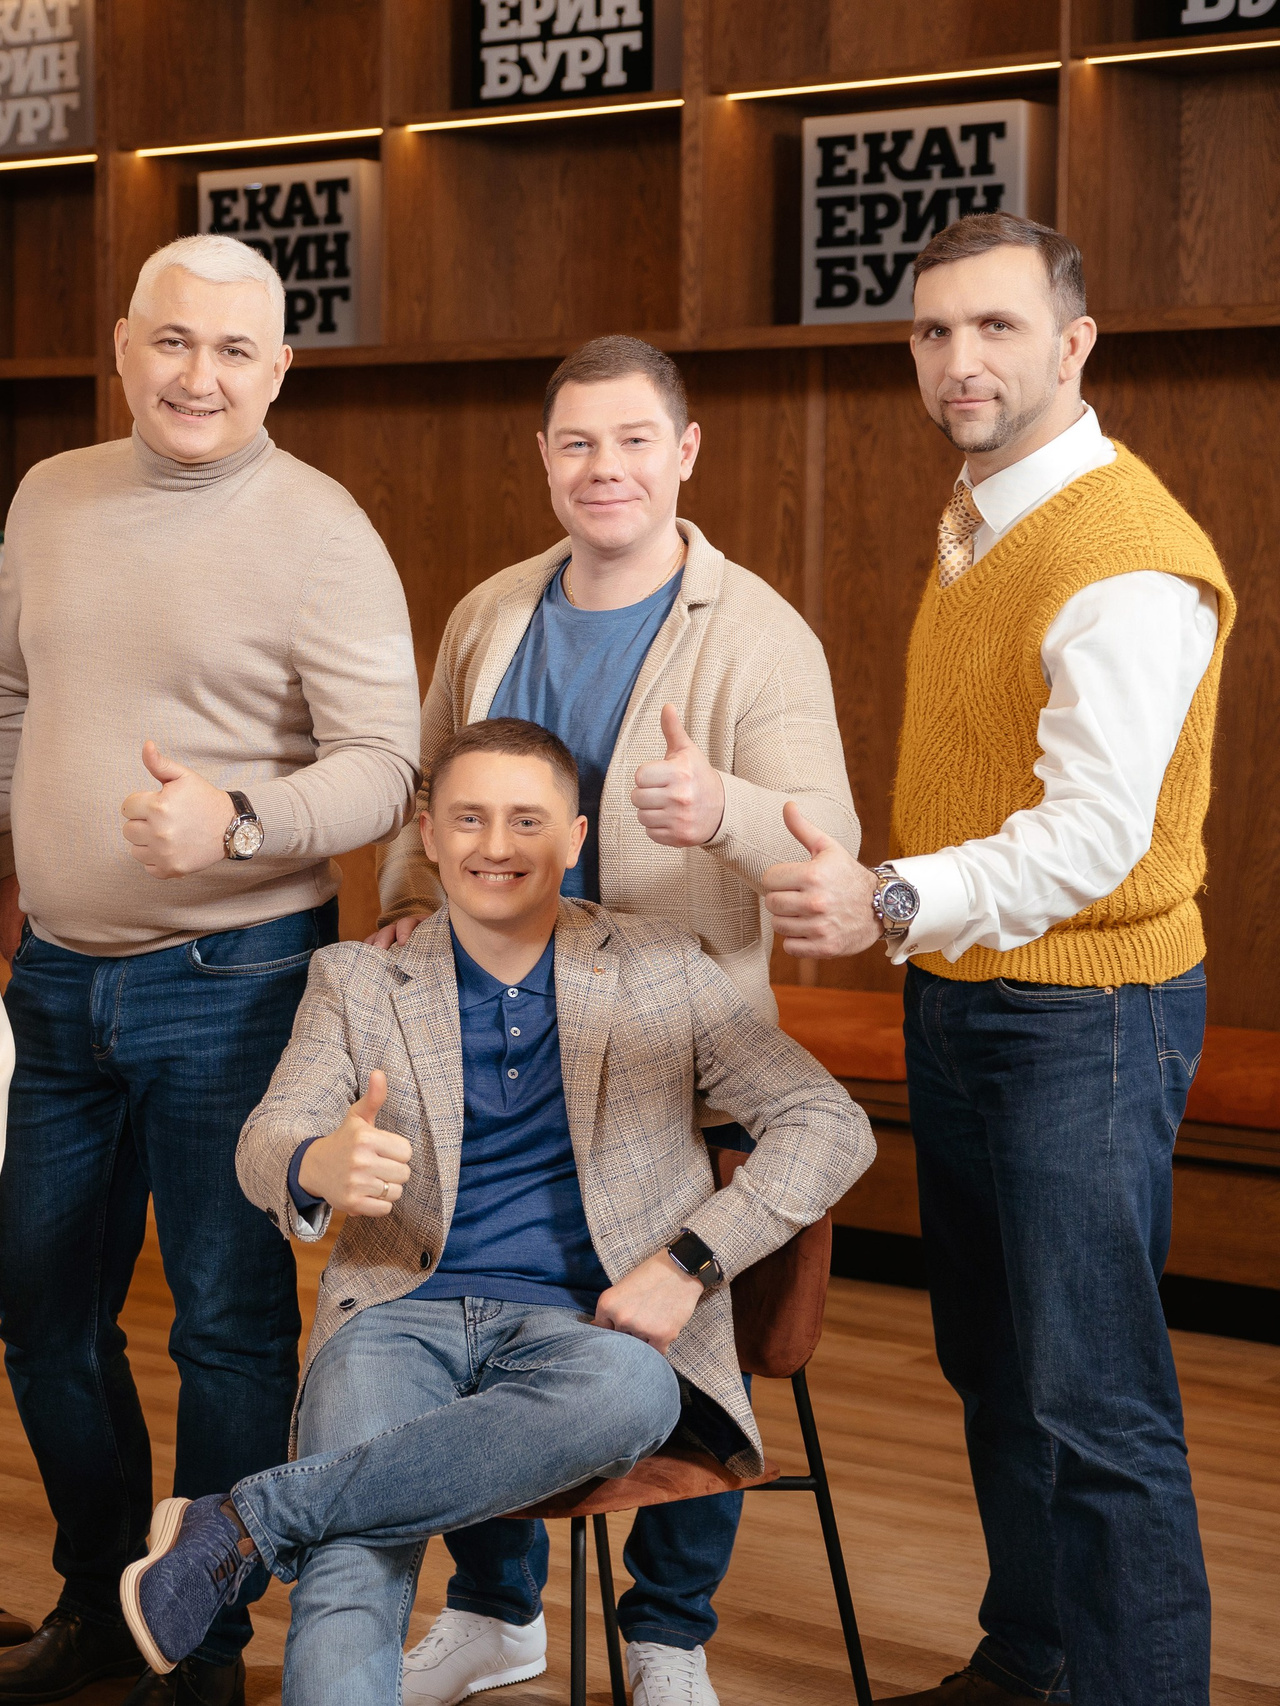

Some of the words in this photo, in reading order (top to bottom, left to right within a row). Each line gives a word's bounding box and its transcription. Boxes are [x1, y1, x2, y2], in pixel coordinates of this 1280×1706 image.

[480, 30, 643, 100] БУРГ
[816, 121, 1007, 188] ЕКАТ
[209, 179, 350, 233] ЕКАТ
[816, 184, 1005, 248] ЕРИН
[242, 231, 350, 281] ИН
[815, 253, 919, 309] БУ
[284, 286, 350, 334] РГ
